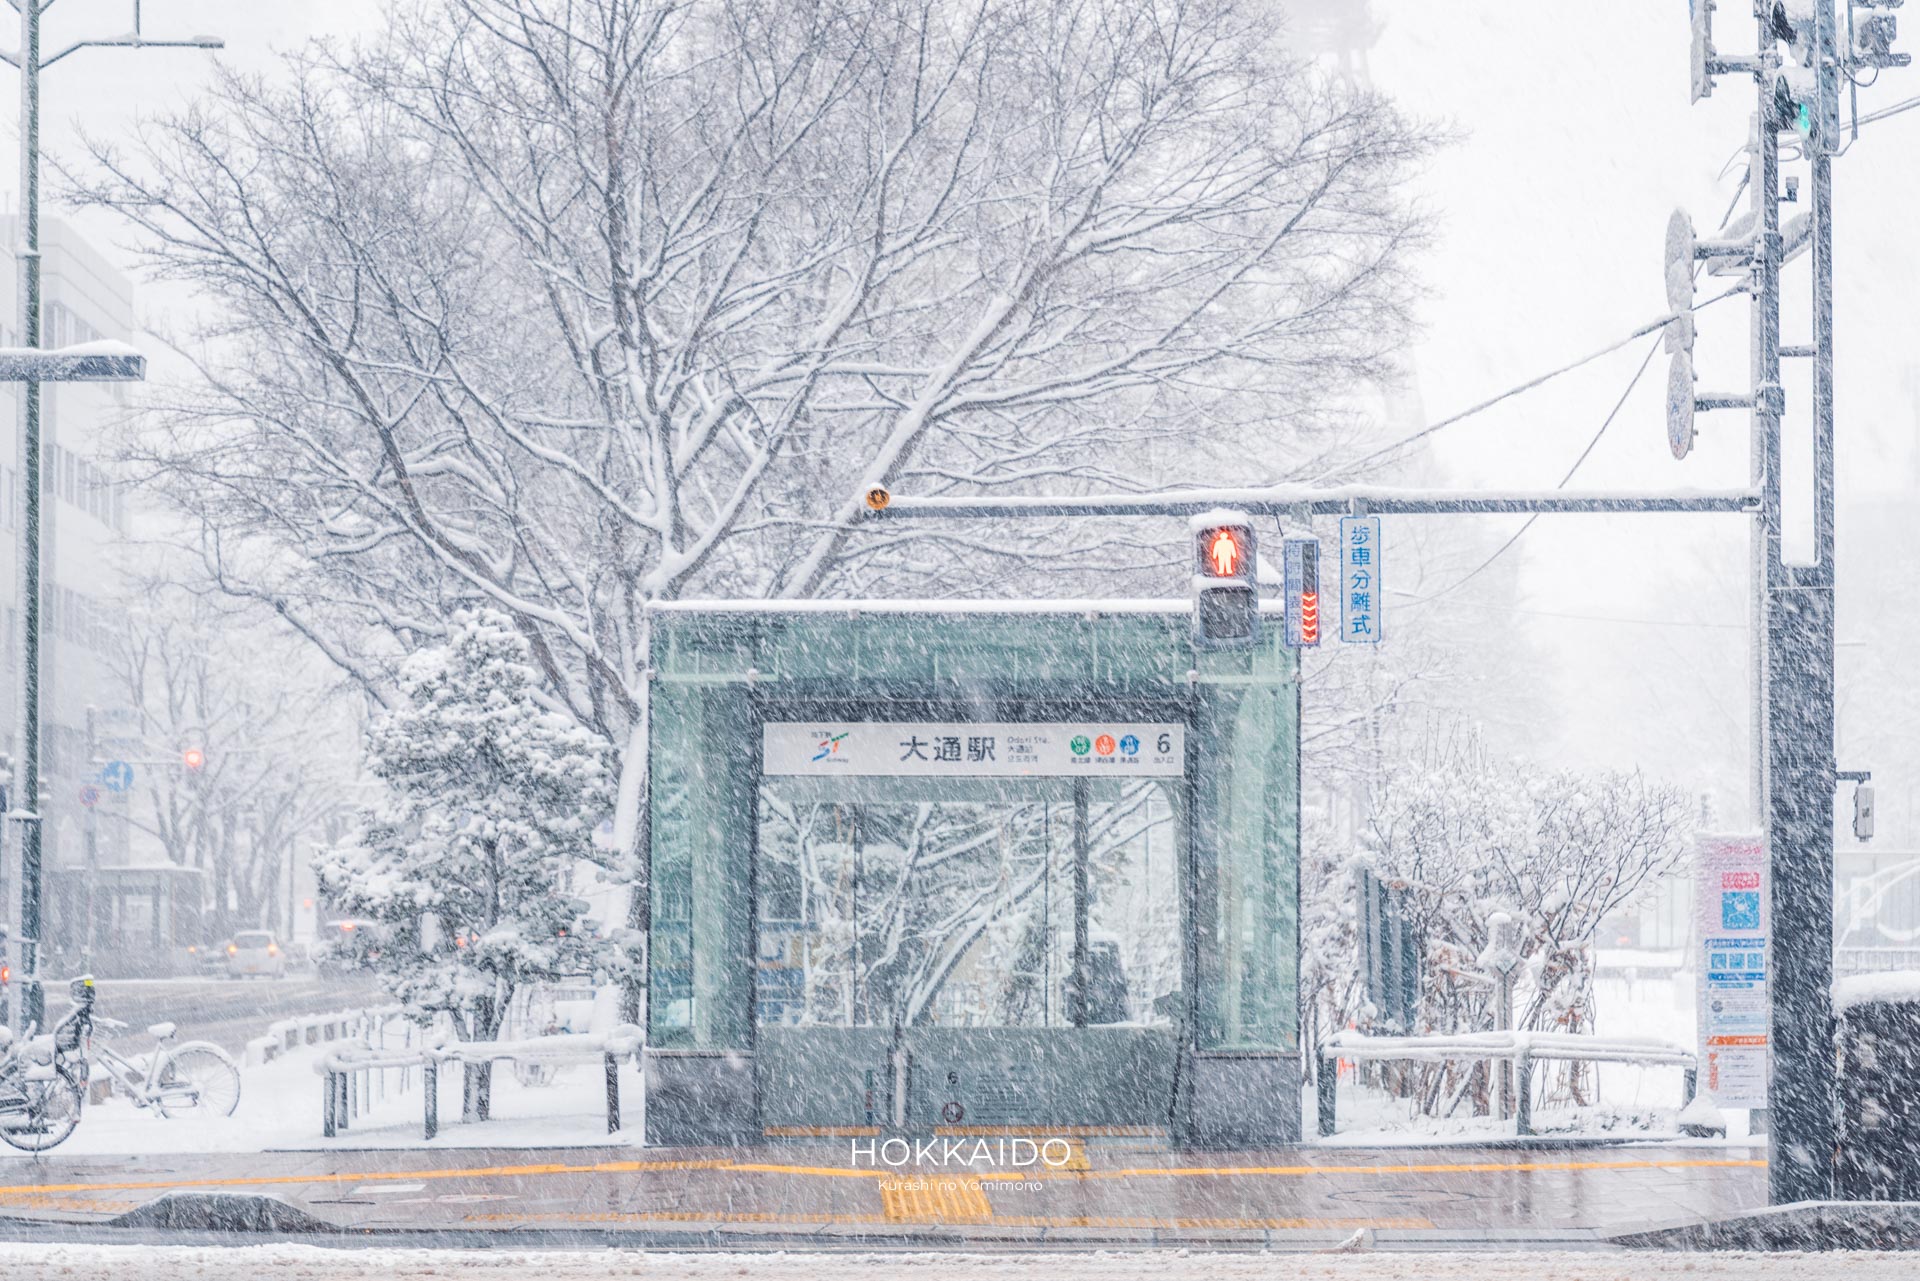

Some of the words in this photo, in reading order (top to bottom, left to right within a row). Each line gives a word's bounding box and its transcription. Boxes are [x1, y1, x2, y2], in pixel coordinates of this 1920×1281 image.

[1350, 526, 1371, 635] 歩車分離式
[899, 735, 996, 762] 大通駅
[1157, 733, 1171, 754] 6
